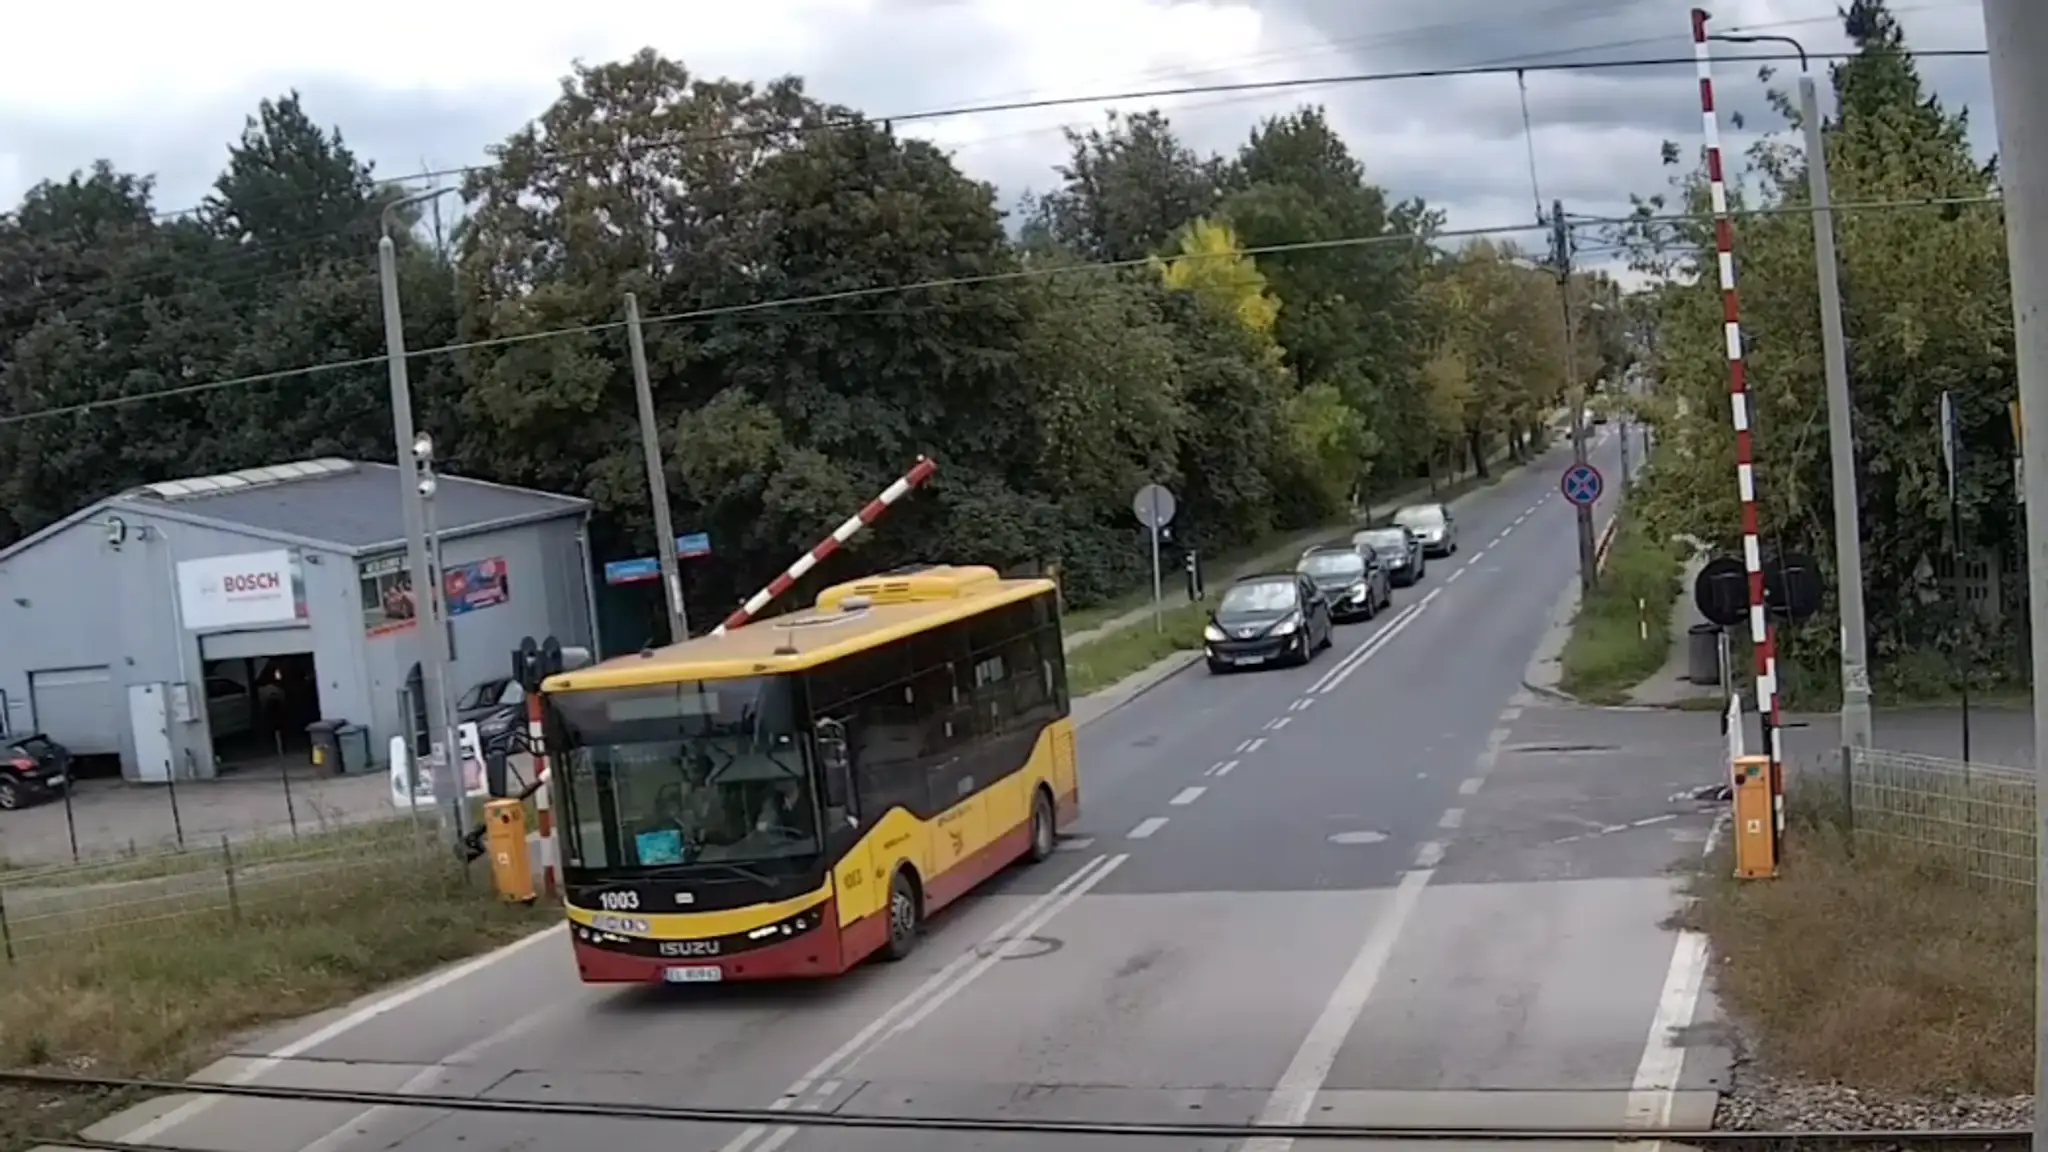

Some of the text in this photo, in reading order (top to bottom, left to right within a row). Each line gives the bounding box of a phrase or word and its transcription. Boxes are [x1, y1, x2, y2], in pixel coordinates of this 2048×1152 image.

[223, 571, 280, 593] BOSCH
[599, 891, 640, 910] 1003
[659, 940, 720, 956] ISUZU
